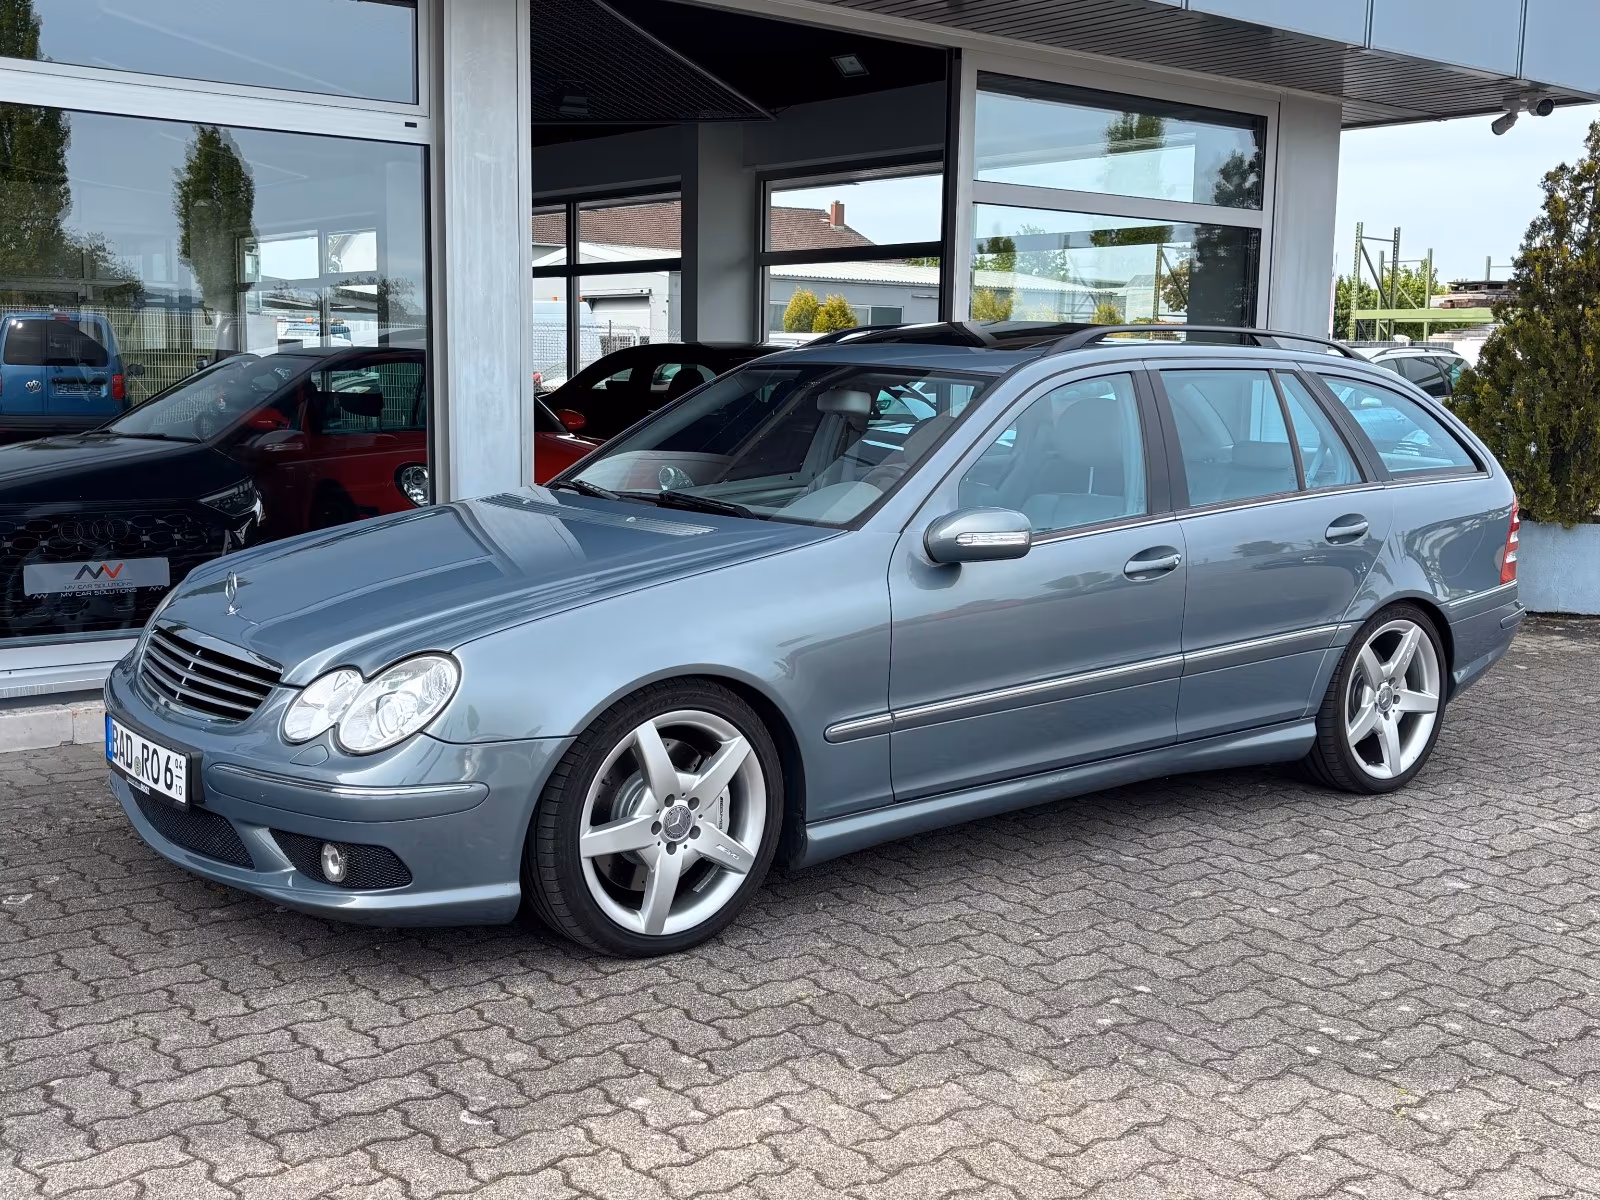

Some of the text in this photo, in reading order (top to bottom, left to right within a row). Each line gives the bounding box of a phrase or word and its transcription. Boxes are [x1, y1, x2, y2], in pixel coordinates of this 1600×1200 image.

[94, 587, 138, 596] SOLUTIONS
[112, 724, 133, 770] BAD
[141, 742, 160, 785] RO
[164, 754, 174, 791] 6
